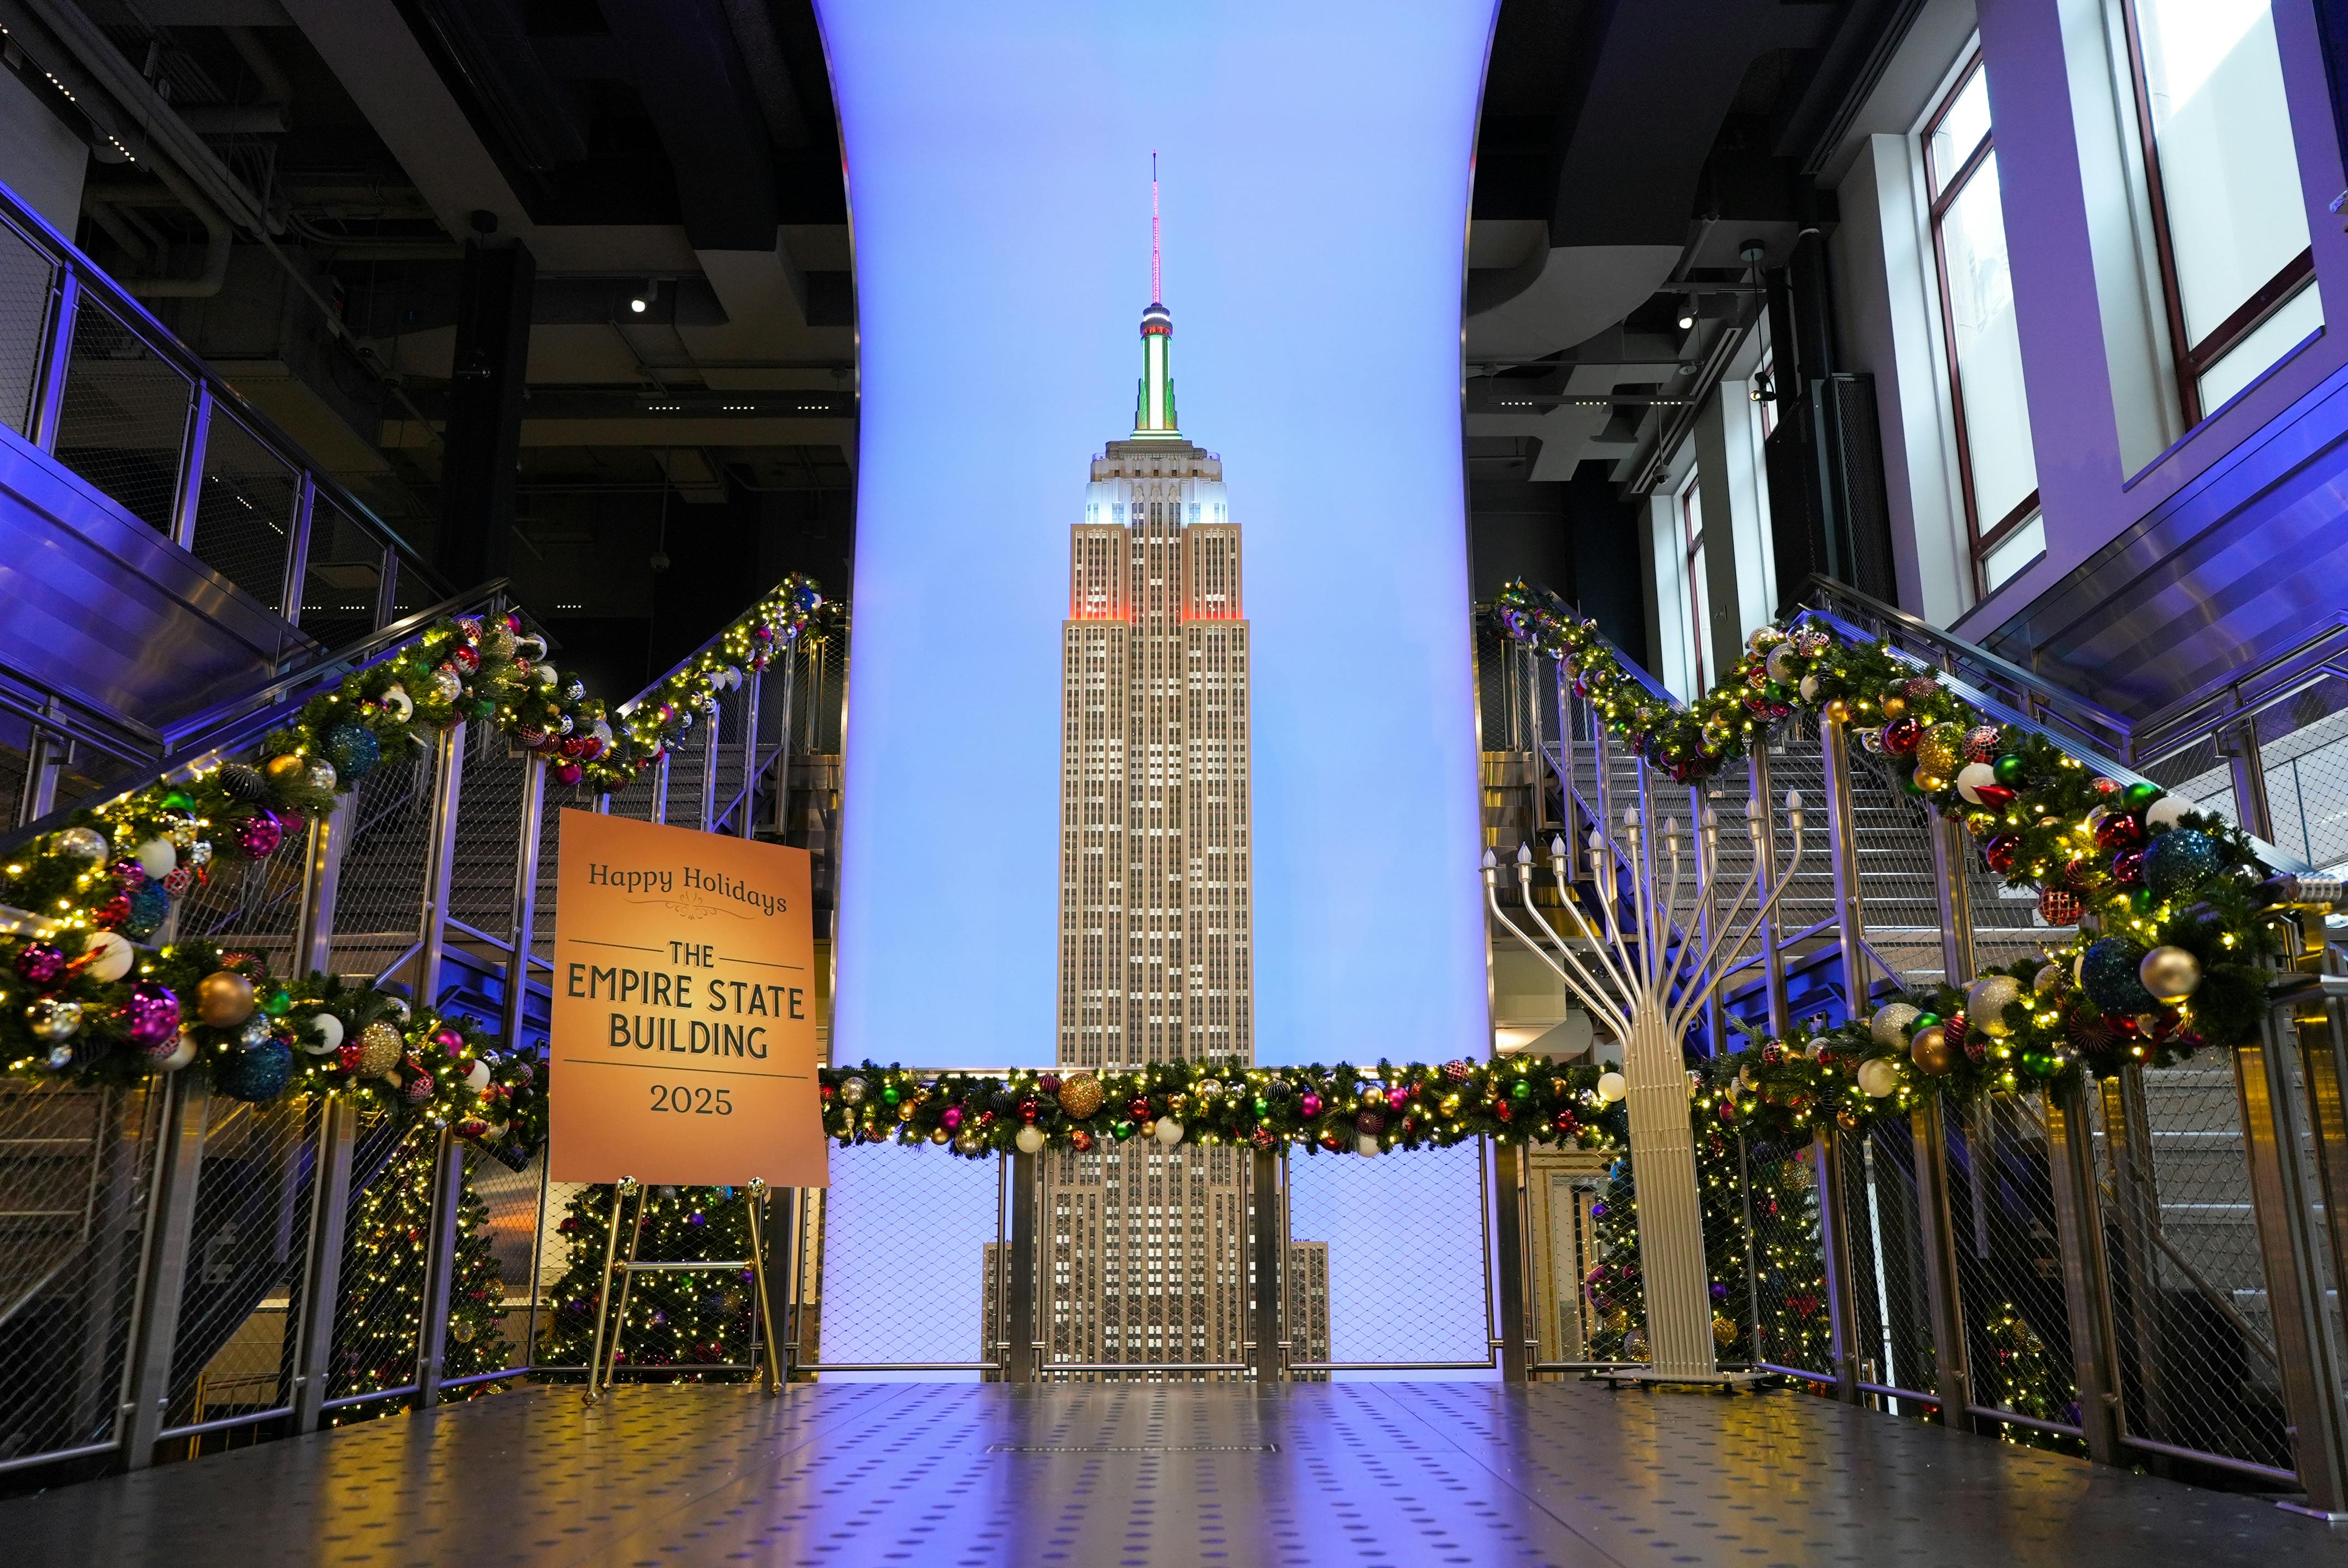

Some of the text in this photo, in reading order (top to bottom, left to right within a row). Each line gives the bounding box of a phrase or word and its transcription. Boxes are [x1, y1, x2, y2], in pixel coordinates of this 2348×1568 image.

[589, 863, 787, 916] Happy Holidays
[668, 941, 714, 968] THE
[567, 963, 805, 1020] EMPIRE STATE
[609, 1013, 768, 1059] BUILDING
[651, 1085, 732, 1115] 2025
